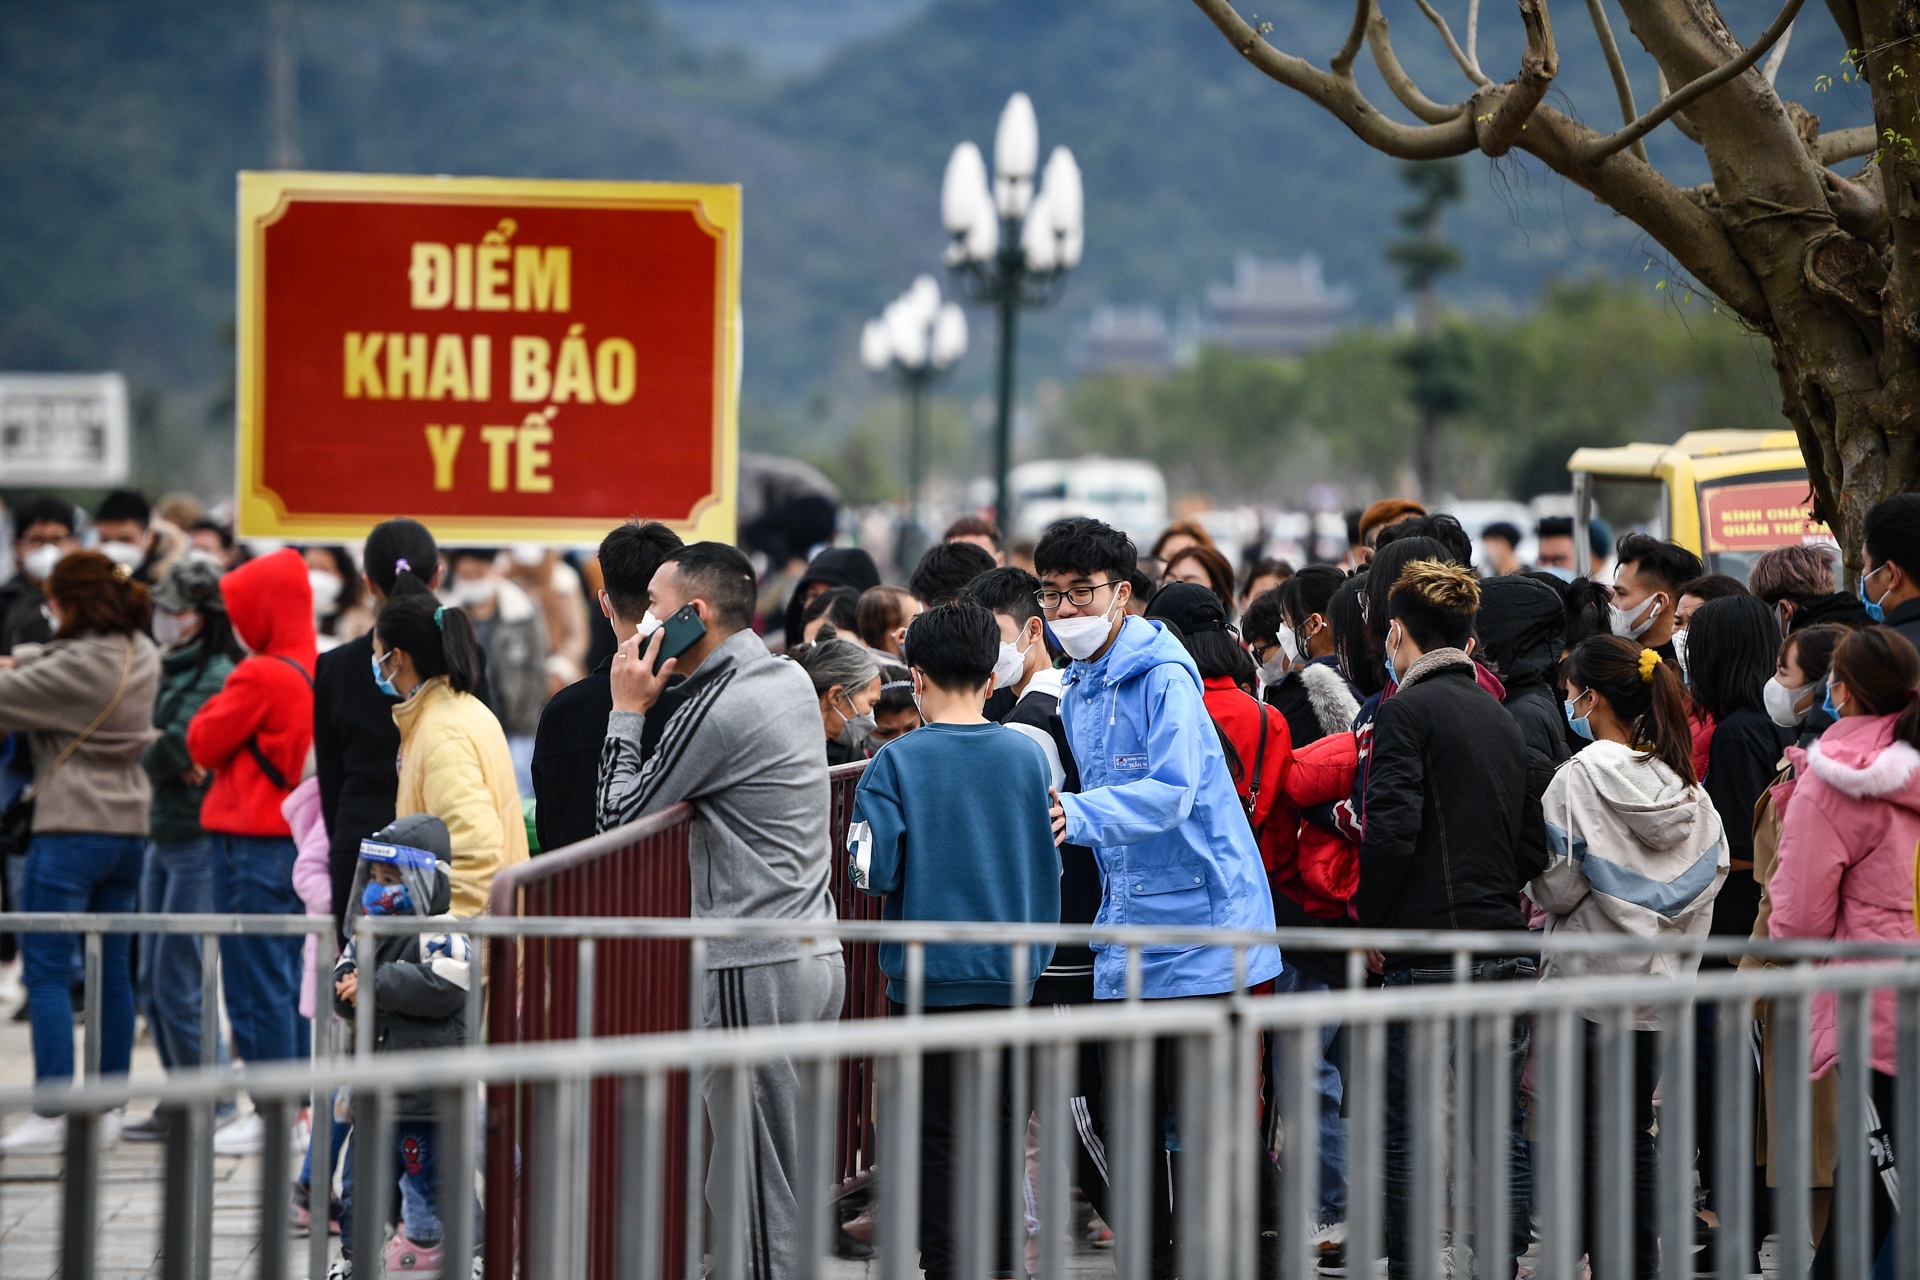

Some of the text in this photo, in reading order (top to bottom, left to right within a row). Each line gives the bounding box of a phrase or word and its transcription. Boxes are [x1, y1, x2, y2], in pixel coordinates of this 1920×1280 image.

[408, 217, 571, 312] ĐIỂM
[344, 323, 636, 405] KHAI BÁO
[424, 405, 559, 492] Y TẾ
